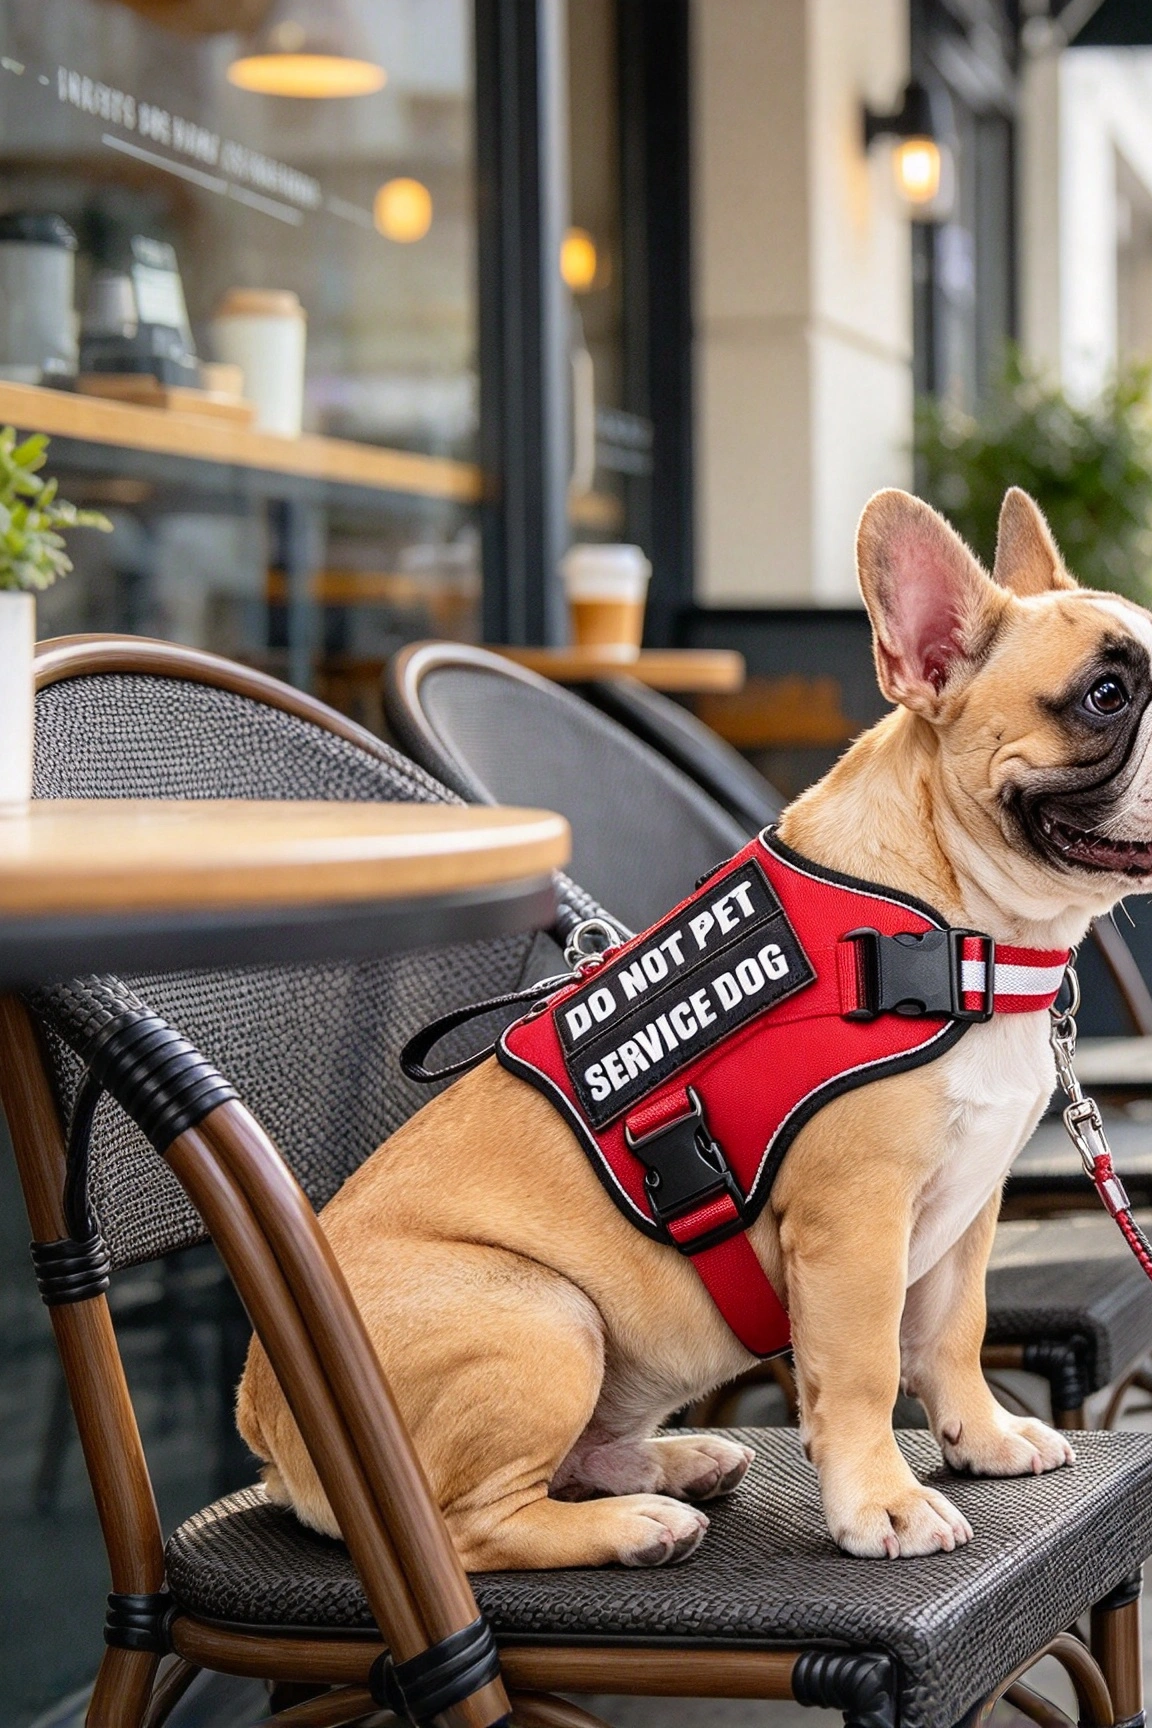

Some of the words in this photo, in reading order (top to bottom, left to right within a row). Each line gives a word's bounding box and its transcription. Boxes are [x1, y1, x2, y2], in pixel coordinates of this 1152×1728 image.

[565, 988, 617, 1041] DO
[618, 930, 684, 1001] NOT
[688, 880, 754, 951] PET
[583, 988, 717, 1101] SERVICE
[711, 944, 789, 1012] DOG
